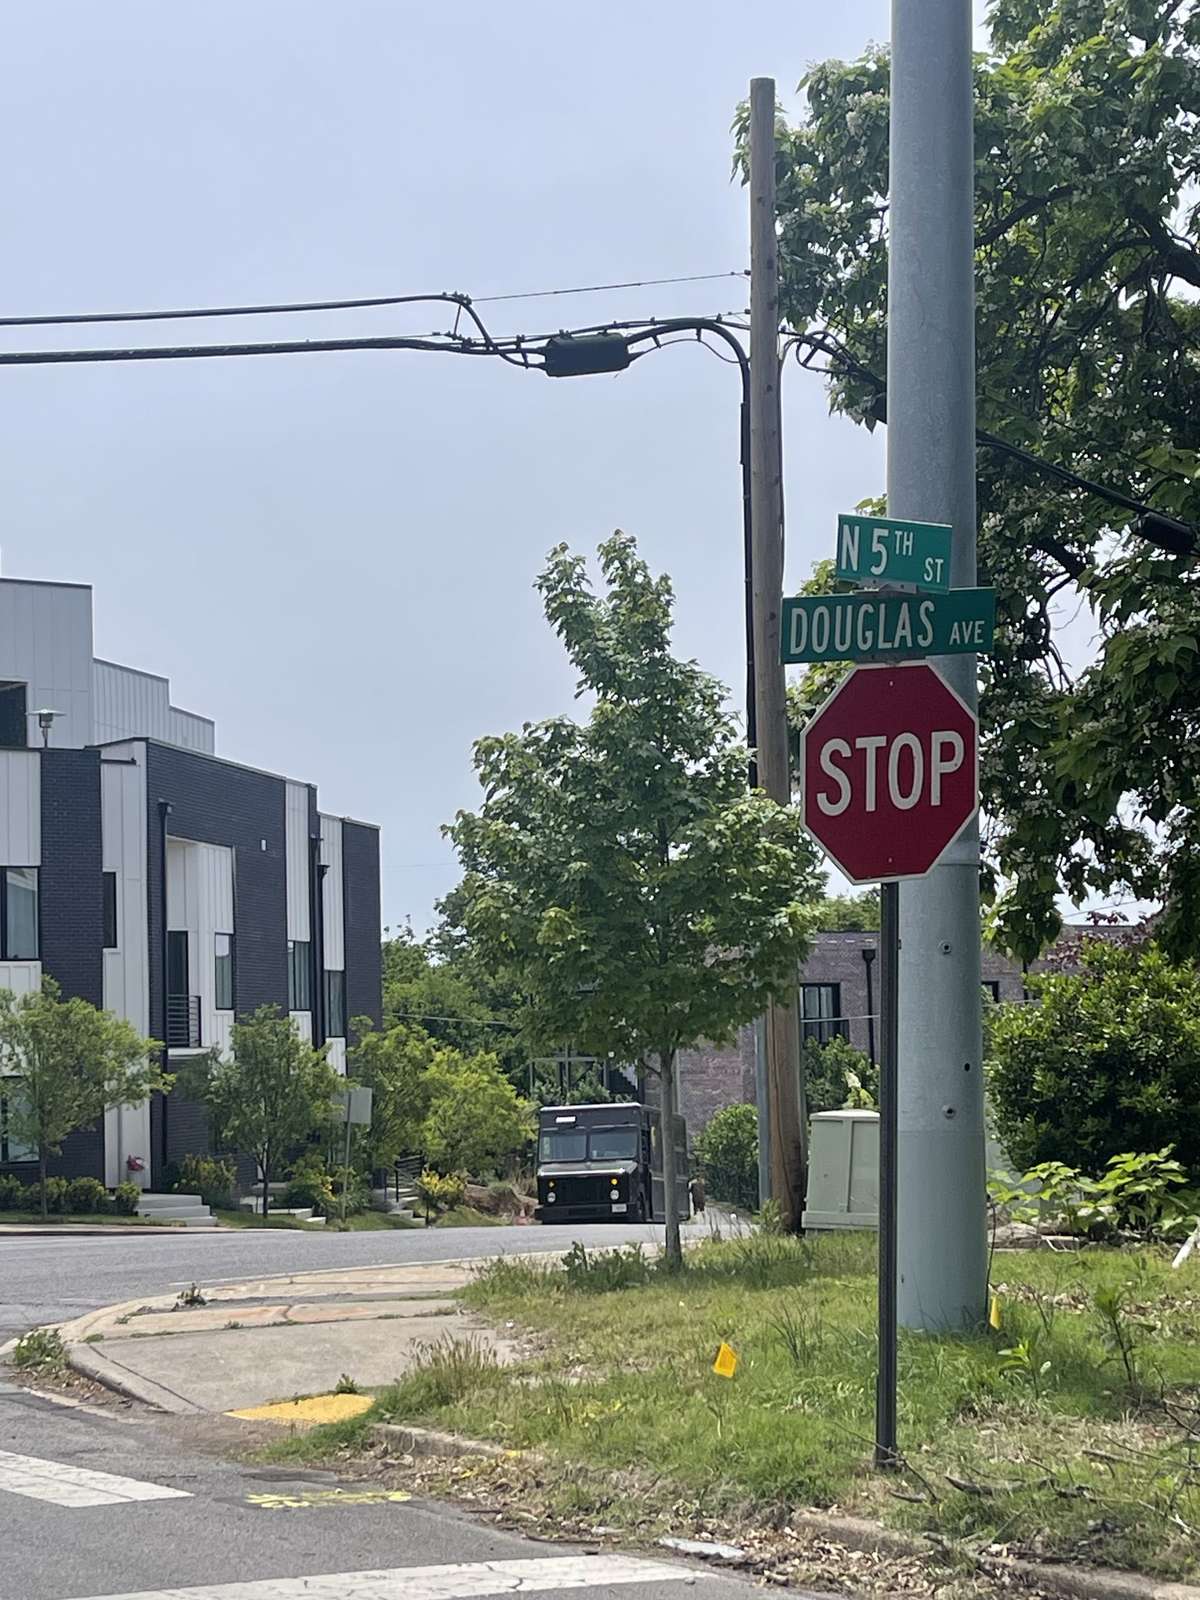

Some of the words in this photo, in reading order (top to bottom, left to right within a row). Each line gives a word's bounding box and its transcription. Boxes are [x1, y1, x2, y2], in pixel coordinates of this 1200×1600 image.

[840, 525, 860, 571] N
[870, 528, 914, 575] 5TH
[924, 558, 944, 583] ST
[790, 601, 935, 654] DOUGLAS
[950, 621, 985, 645] AVE
[817, 731, 964, 816] STOP
